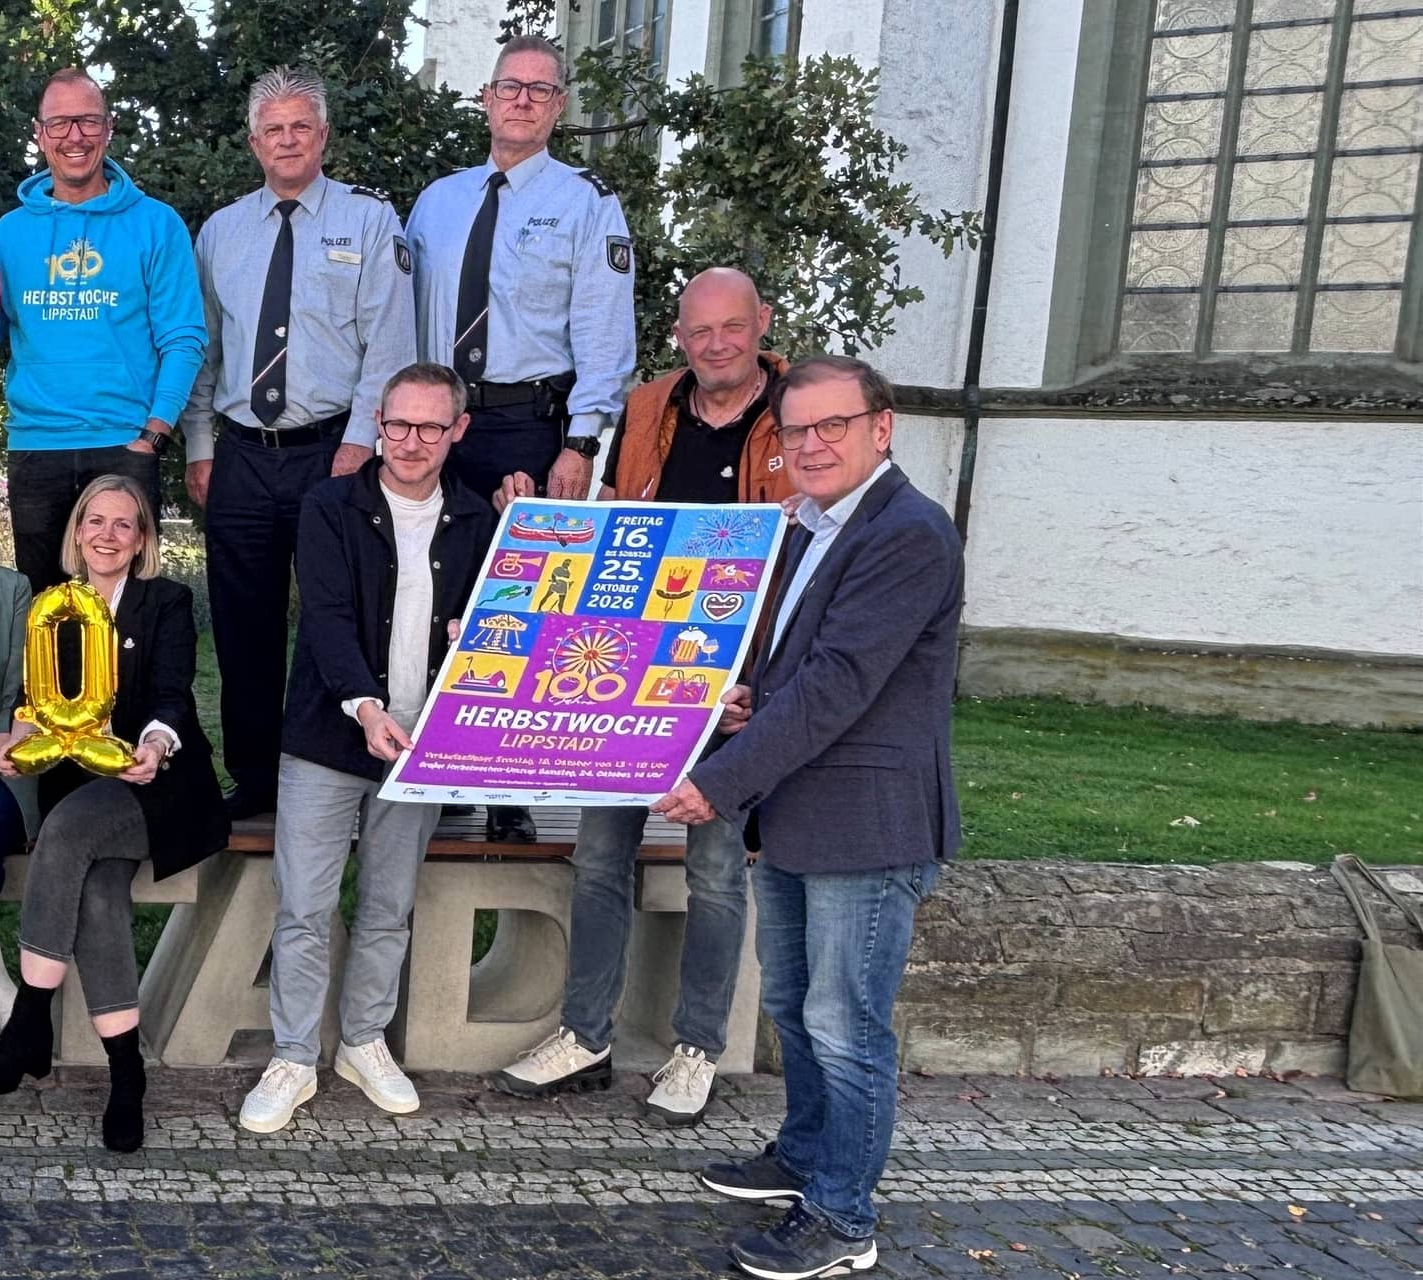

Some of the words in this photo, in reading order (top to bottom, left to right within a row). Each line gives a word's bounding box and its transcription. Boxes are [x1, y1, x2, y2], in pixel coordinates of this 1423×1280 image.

[42, 307, 99, 321] LIPPSTADT
[615, 516, 664, 527] FREITAG
[612, 526, 654, 549] 16.
[598, 560, 644, 582] 25.
[592, 583, 639, 594] OKTOBER
[586, 594, 635, 610] 2026
[531, 668, 627, 704] 100
[453, 704, 679, 737] HERBSTWOCHE
[498, 733, 607, 752] LIPPSTADT
